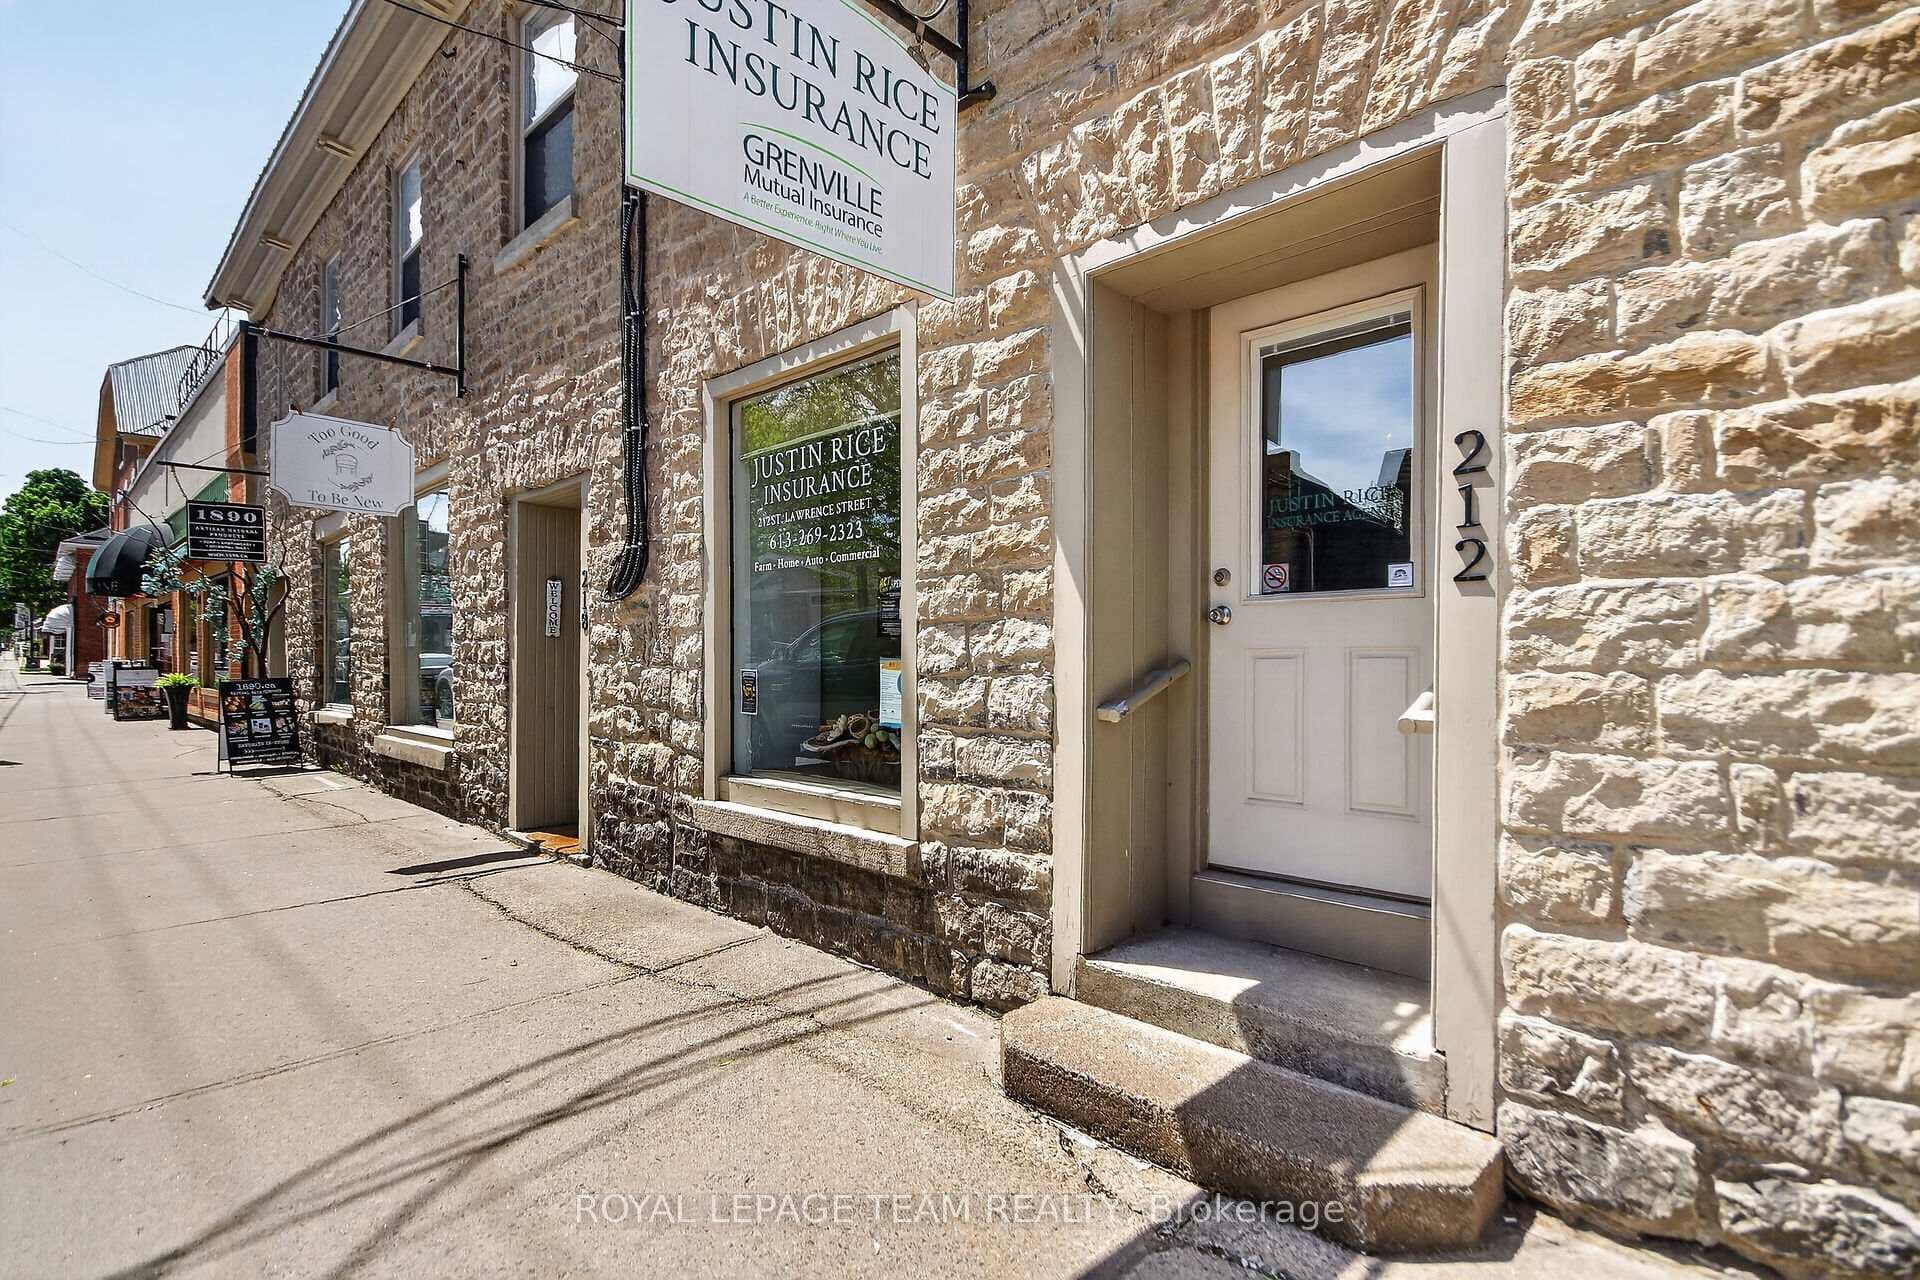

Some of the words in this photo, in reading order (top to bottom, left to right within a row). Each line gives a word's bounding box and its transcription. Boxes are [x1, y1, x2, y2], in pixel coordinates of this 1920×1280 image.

[661, 0, 841, 78] STIN
[852, 50, 940, 135] RICE
[684, 18, 932, 180] INSURANCE
[743, 134, 883, 218] GRENVILLE
[743, 192, 750, 203] A
[751, 194, 773, 212] Better
[744, 164, 805, 206] Mutual
[810, 190, 883, 238] Insurance
[305, 428, 336, 444] Too
[340, 426, 380, 450] Good
[751, 441, 825, 488] JUSTIN
[831, 425, 887, 463] RICE
[307, 489, 326, 502] To
[332, 493, 349, 505] Be
[354, 495, 384, 509] New
[764, 463, 873, 505] INSURANCE
[196, 509, 257, 523] 1890
[785, 504, 835, 523] LAWRENCE
[836, 497, 873, 515] STREET
[1267, 493, 1335, 518] JUSTIN
[1268, 509, 1341, 529] INSURANCE
[1453, 430, 1486, 582] 212
[769, 520, 864, 550] 613-269-2323
[754, 561, 772, 573] Farm
[777, 558, 800, 570] Home
[805, 555, 824, 567] Auto
[830, 546, 880, 563] Commercial
[548, 582, 559, 634] WELCOME
